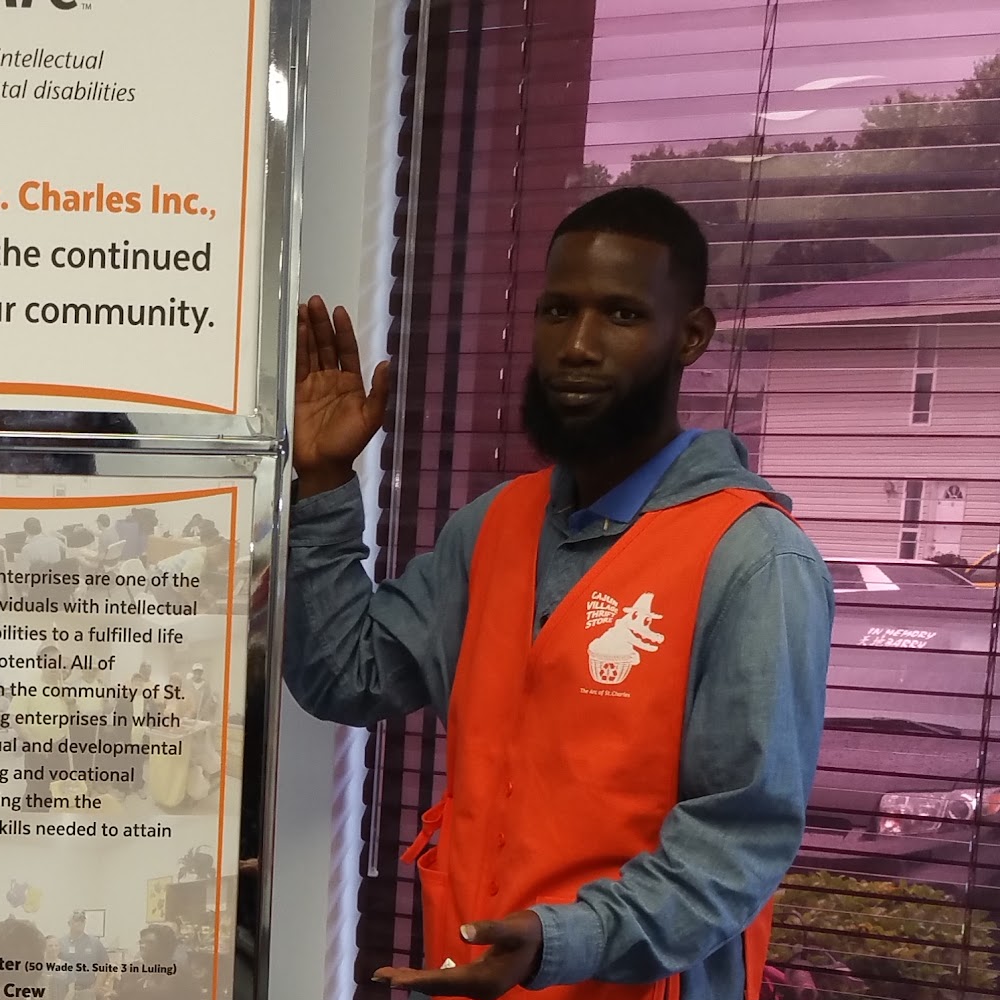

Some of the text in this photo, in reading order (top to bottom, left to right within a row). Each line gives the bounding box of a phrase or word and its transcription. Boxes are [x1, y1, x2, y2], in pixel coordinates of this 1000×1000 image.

[34, 80, 135, 101] disabilities
[19, 181, 141, 213] Charles
[152, 184, 216, 219] Inc.,
[51, 240, 210, 271] continued
[25, 298, 214, 333] community.
[84, 574, 111, 586] are
[115, 574, 147, 587] one
[151, 571, 169, 587] of
[171, 572, 200, 588] the
[63, 597, 100, 614] with
[104, 598, 197, 616] intellectual
[591, 591, 618, 606] CAJUN
[585, 610, 616, 621] THRIFT
[586, 601, 618, 614] VILLAGE
[585, 617, 613, 629] STORE
[51, 627, 70, 642] to
[73, 630, 84, 642] a
[89, 626, 153, 644] fulfilled
[158, 628, 183, 644] life
[884, 628, 937, 640] MEMORY
[70, 654, 93, 670] All
[97, 655, 116, 671] of
[9, 681, 38, 697] the
[42, 683, 138, 703] community
[142, 684, 161, 700] of
[163, 684, 185, 700] St.
[15, 710, 108, 729] enterprises
[112, 711, 127, 727] in
[131, 712, 180, 728] which
[21, 737, 53, 753] and
[58, 738, 183, 758] developmental
[13, 765, 44, 781] and
[48, 766, 135, 782] vocational
[25, 793, 70, 809] them
[74, 793, 102, 809] the
[36, 821, 97, 837] needed
[101, 822, 119, 837] to
[123, 822, 172, 838] attain
[24, 960, 44, 973] (50
[45, 962, 74, 972] Wade
[75, 962, 90, 972] St.
[91, 962, 119, 973] Suite
[120, 963, 128, 973] 3
[129, 963, 140, 973] in
[141, 963, 177, 976] Luling)
[3, 982, 46, 998] Crew
